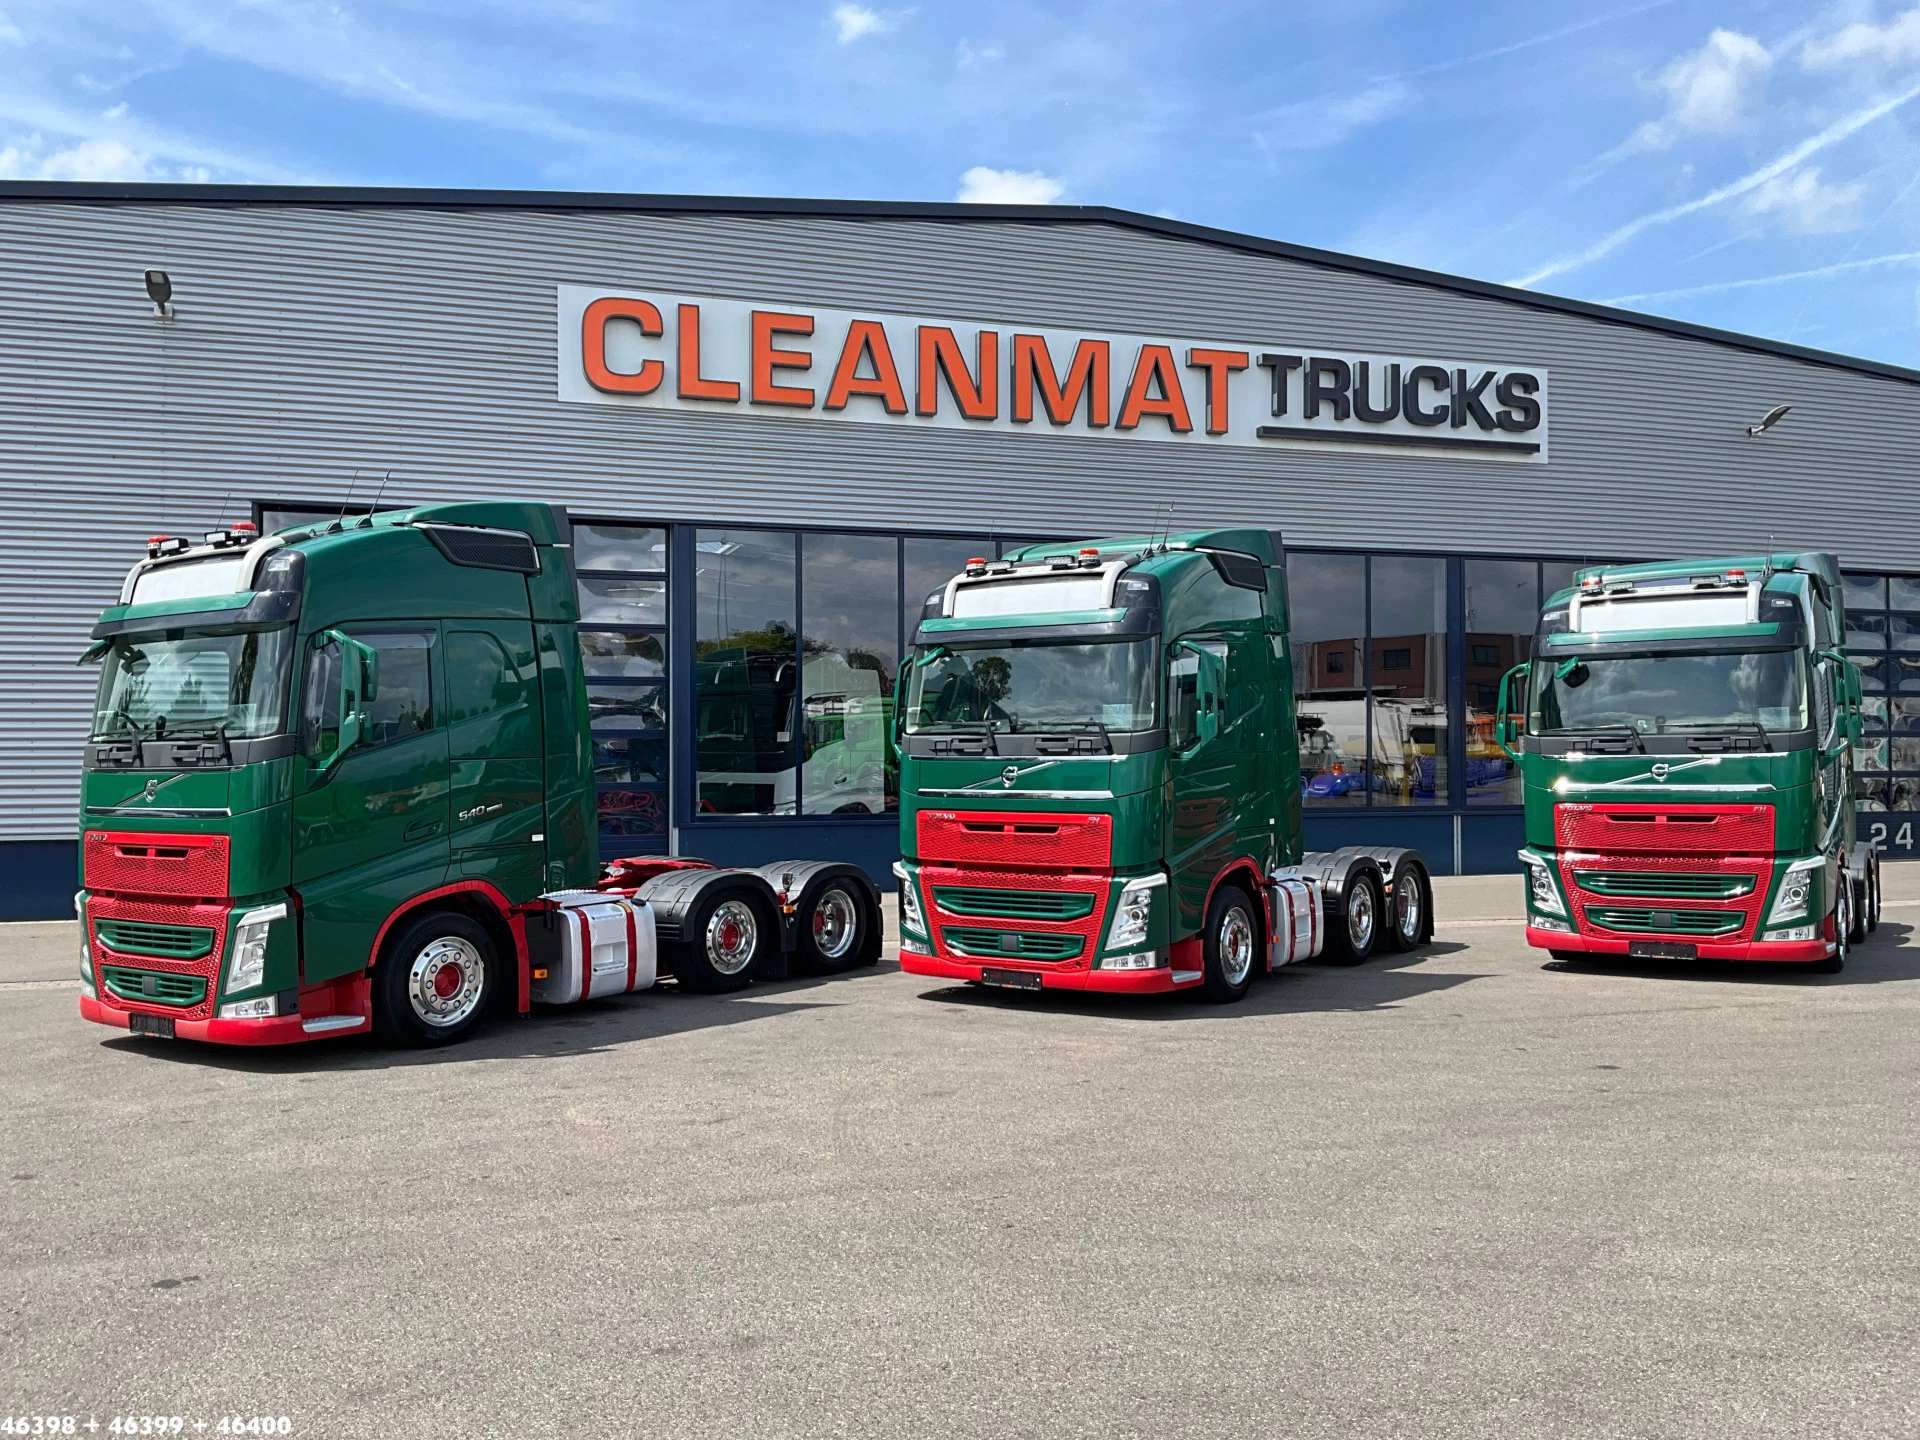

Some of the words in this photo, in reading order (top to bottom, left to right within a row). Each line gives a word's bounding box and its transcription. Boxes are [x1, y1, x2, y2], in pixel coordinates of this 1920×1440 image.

[582, 297, 1249, 435] CLEANMAT
[1256, 353, 1541, 432] TRUCKS
[459, 805, 485, 821] 540
[1870, 822, 1914, 851] 24
